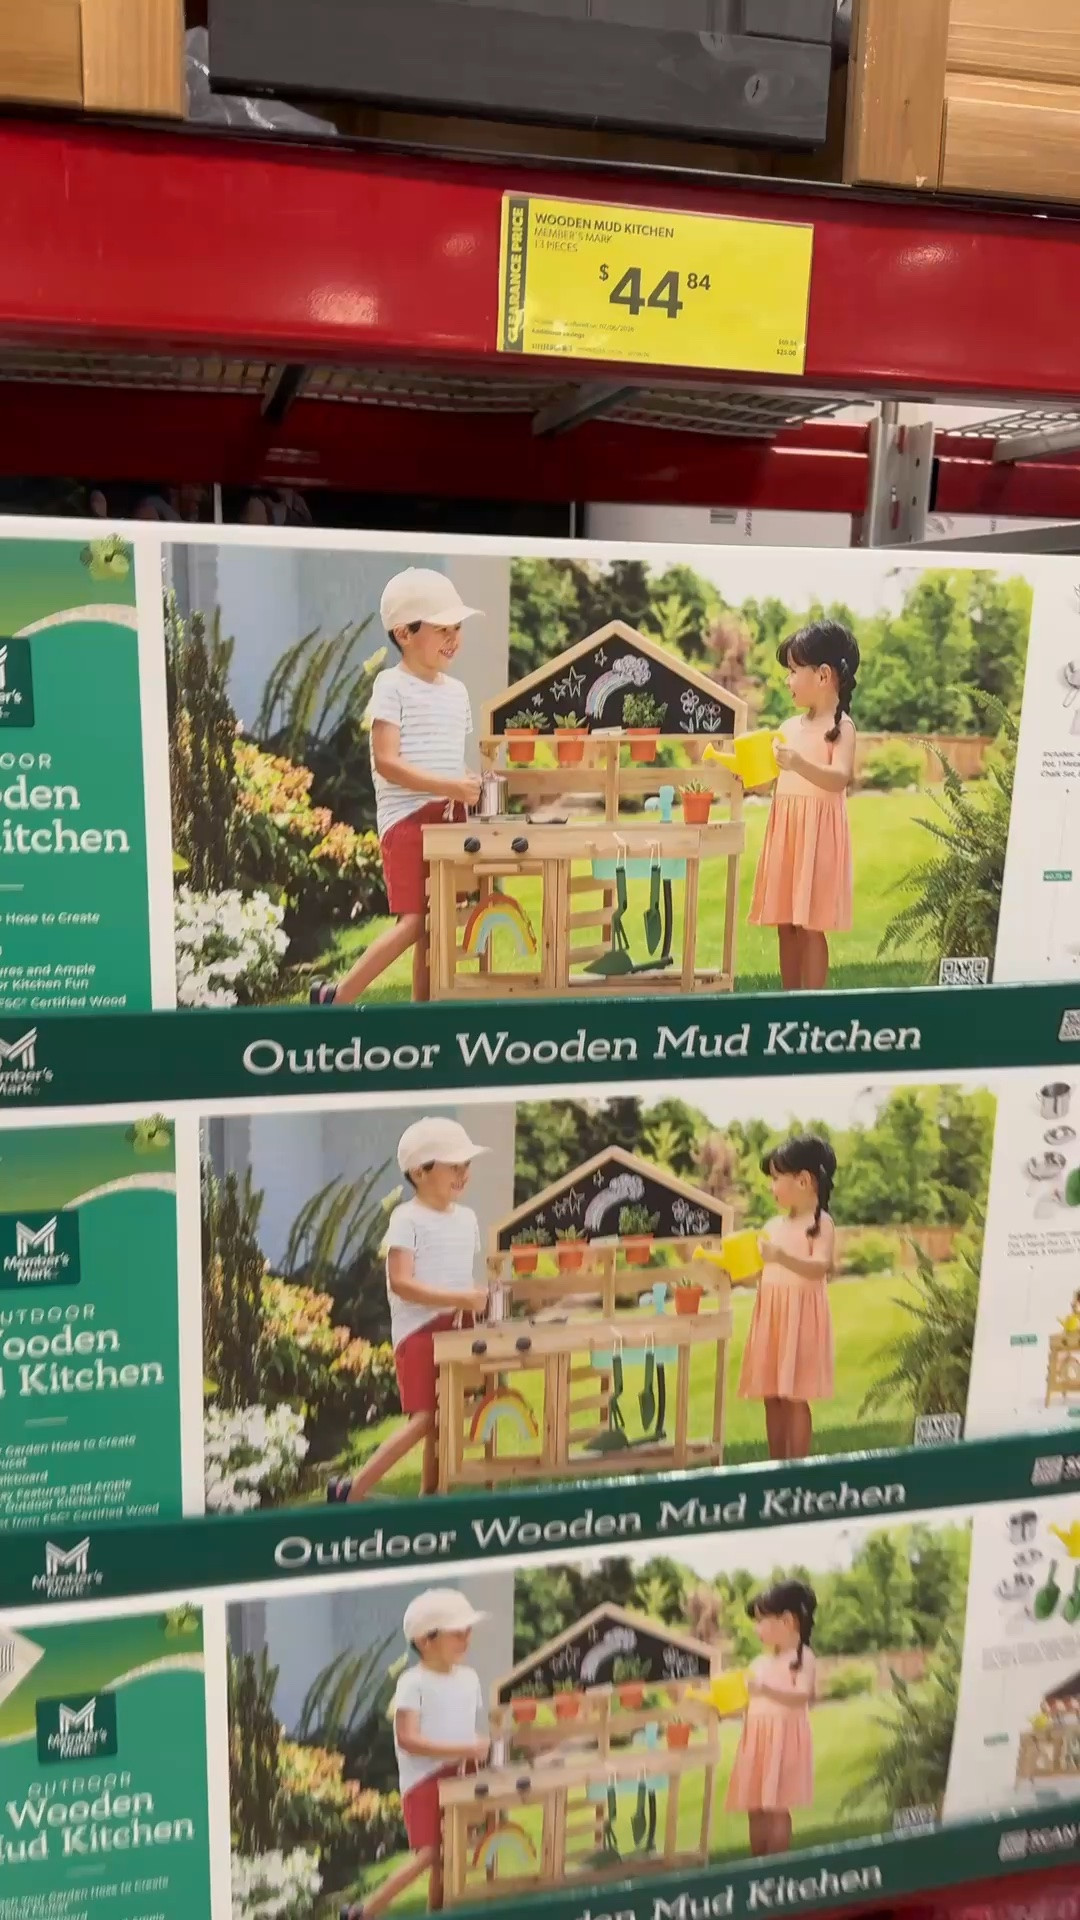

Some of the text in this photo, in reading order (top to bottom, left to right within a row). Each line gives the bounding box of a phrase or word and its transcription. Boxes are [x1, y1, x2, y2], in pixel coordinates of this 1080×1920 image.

[534, 227, 612, 243] MEMBER'S MARK
[535, 213, 674, 239] WOODEN MUD KITCHEN
[546, 242, 578, 252] PIECES
[507, 207, 524, 343] CLEARANCE PRICE
[609, 267, 683, 319] 44
[686, 272, 711, 290] 84
[0, 774, 81, 811] den
[0, 818, 131, 854] itchen
[6, 911, 100, 925] Hose to Create
[13, 978, 61, 991] Kitchen
[65, 978, 89, 990] Fun
[27, 964, 51, 976] and
[54, 963, 96, 977] Ample
[30, 996, 86, 1009] Certified
[89, 994, 127, 1008] Wood
[242, 1018, 922, 1077] Outdoor Wooden Mud Kitchen
[0, 1324, 120, 1361] ooden
[19, 1358, 165, 1397] Kitchen
[273, 1478, 906, 1569] Outdoor Wooden Mud Kitchen
[5, 1790, 154, 1831] Wooden
[61, 1816, 195, 1857] Kitchen
[652, 1865, 882, 1920] Mud Kitchen
